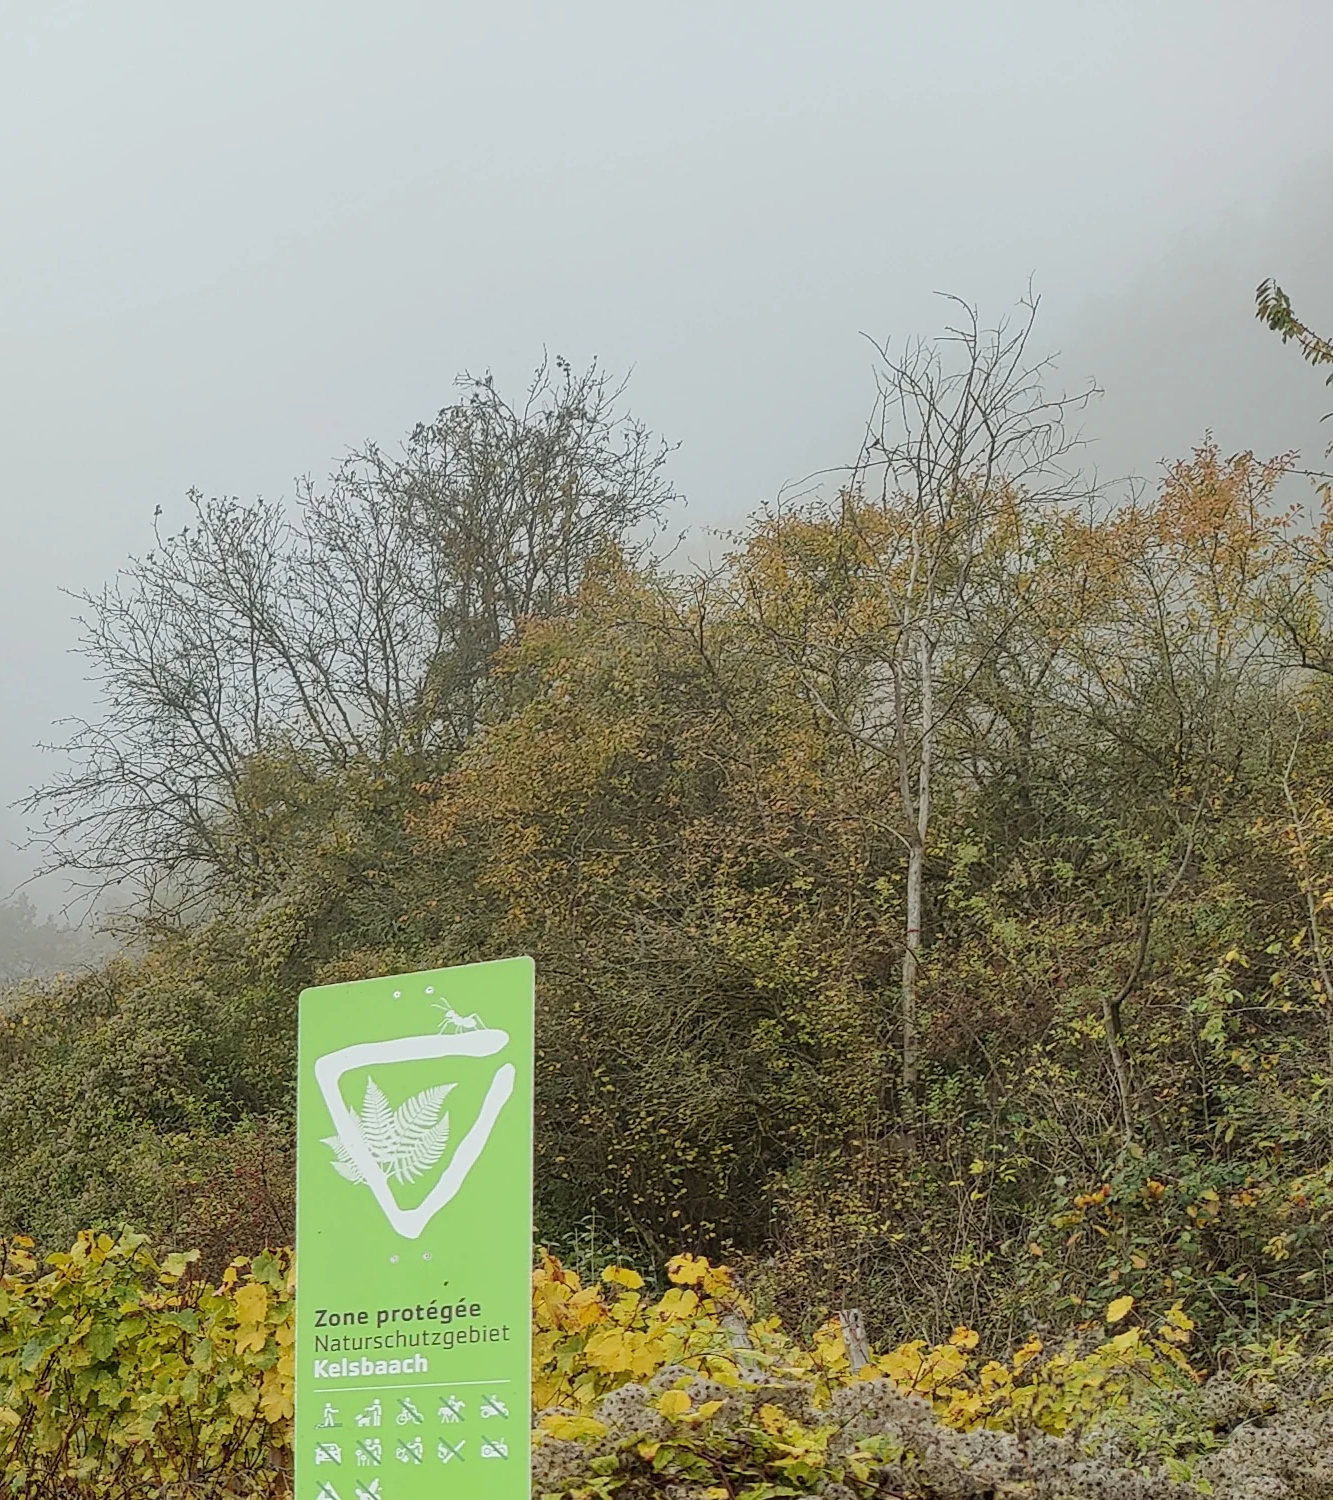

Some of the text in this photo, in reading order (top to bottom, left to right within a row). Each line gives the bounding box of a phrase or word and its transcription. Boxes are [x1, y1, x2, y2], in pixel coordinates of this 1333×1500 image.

[314, 1297, 482, 1328] Zone protégée
[314, 1325, 510, 1352] Naturschutzgebiet
[313, 1353, 428, 1379] Kelsbaach
